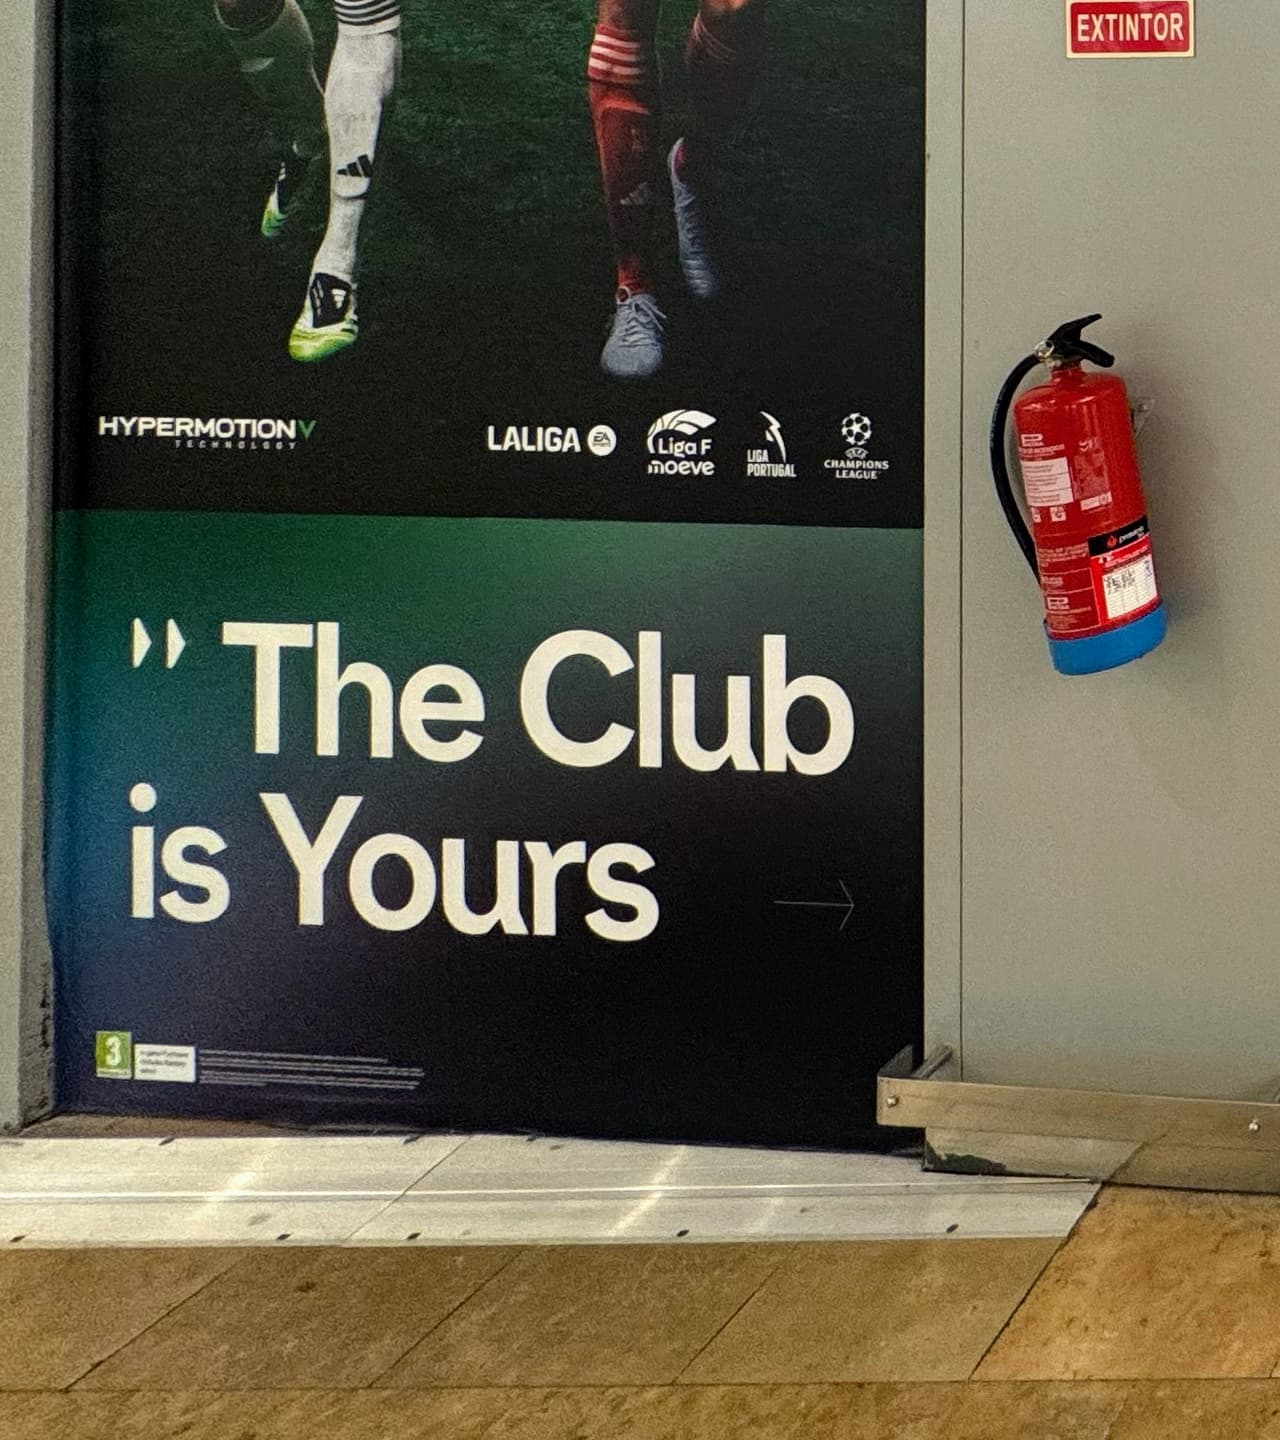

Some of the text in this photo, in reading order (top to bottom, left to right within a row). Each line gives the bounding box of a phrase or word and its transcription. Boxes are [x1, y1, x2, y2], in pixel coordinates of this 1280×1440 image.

[1076, 12, 1185, 44] EXTINTOR
[175, 439, 297, 450] TECHNOLOGY
[487, 425, 582, 453] LALIGA
[658, 436, 712, 458] Liga F
[747, 449, 769, 463] LIGA
[824, 459, 890, 470] CHAMPIONS
[647, 460, 715, 477] moeve
[747, 463, 796, 478] PORTUGAL
[835, 469, 878, 480] LEAGUE
[221, 620, 856, 776] The Club
[130, 783, 660, 942] is Yours
[105, 1035, 122, 1067] 3
